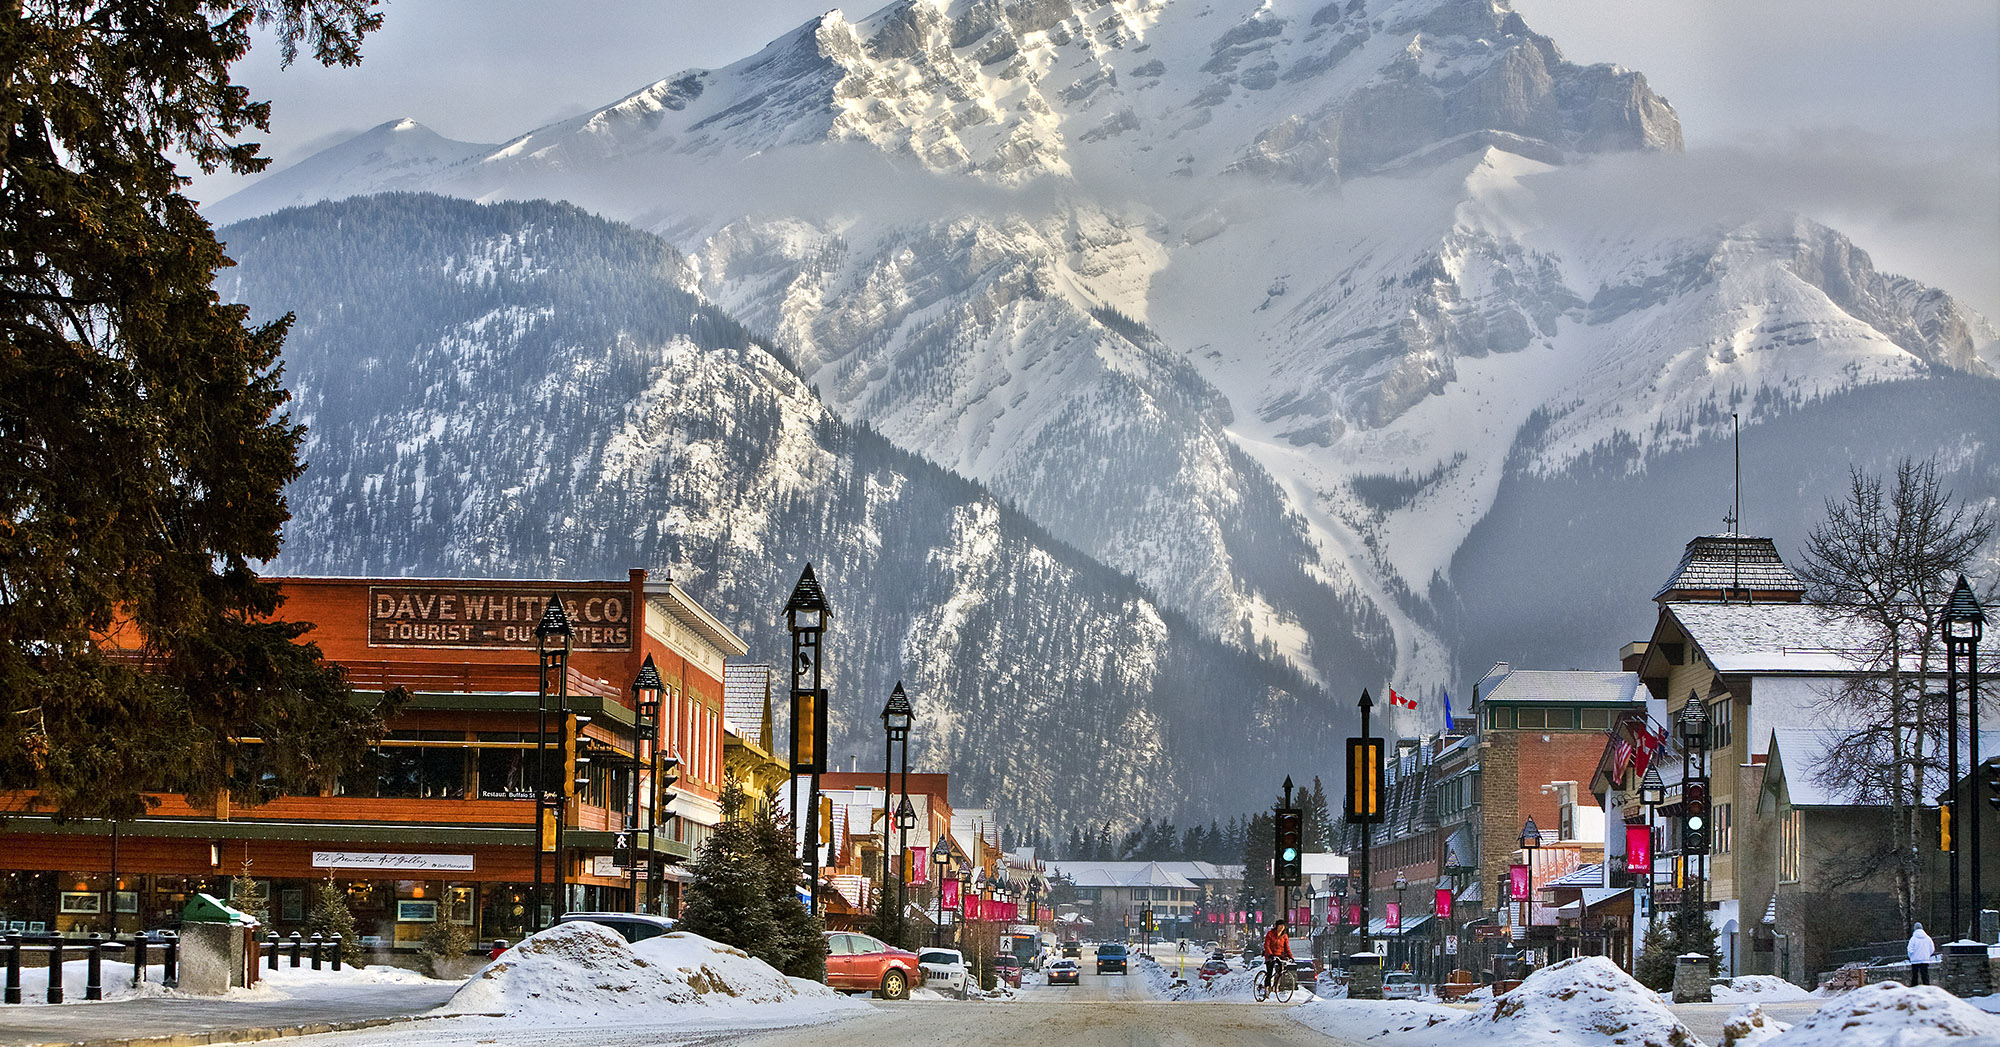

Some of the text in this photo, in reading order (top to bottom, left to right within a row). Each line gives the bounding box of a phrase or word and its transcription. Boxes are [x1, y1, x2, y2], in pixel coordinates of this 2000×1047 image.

[376, 594, 457, 620] DAVE
[565, 600, 580, 622] &
[584, 597, 628, 623] CO.
[385, 623, 474, 641] TOURIST
[503, 625, 628, 644] OUTERS
[315, 852, 428, 868] The Mountain Art Gallery
